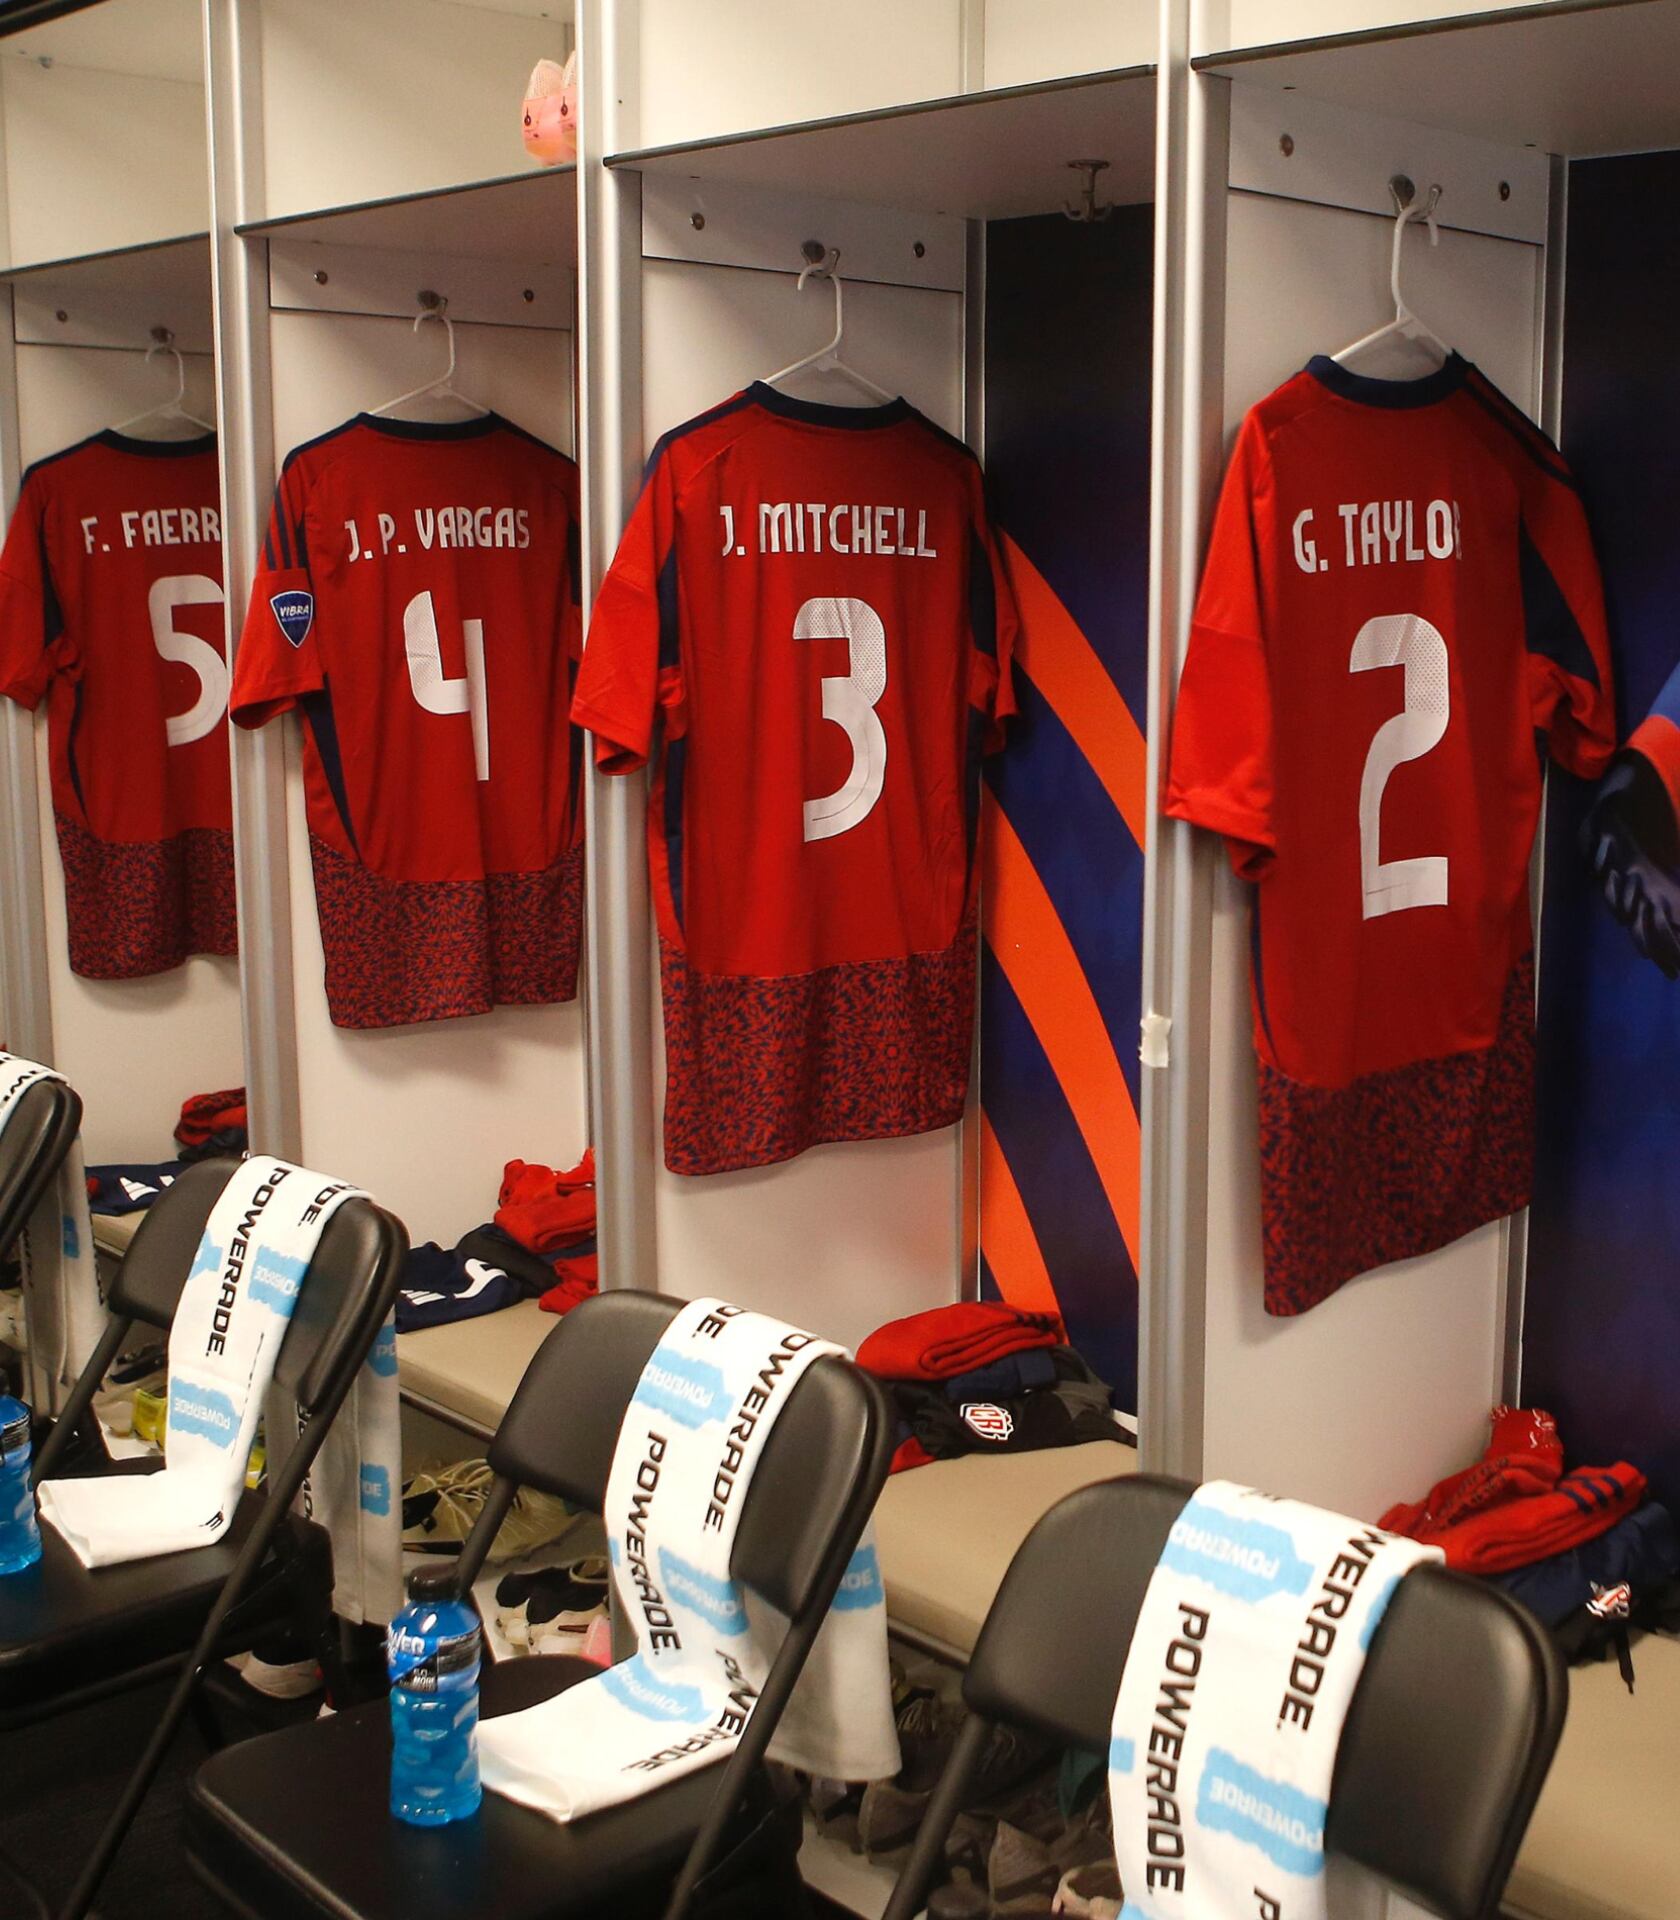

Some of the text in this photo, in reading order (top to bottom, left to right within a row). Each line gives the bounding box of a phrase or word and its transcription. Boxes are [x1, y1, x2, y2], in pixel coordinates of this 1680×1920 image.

[80, 516, 111, 555] F.
[344, 506, 530, 563] J. P. VARGAS
[719, 502, 937, 558] J. MITCHELL
[1292, 508, 1329, 574] G.
[280, 605, 310, 617] VIBRA
[148, 574, 228, 747] 5
[403, 590, 490, 782] 4
[792, 596, 887, 843] 3
[1348, 613, 1450, 921] 2
